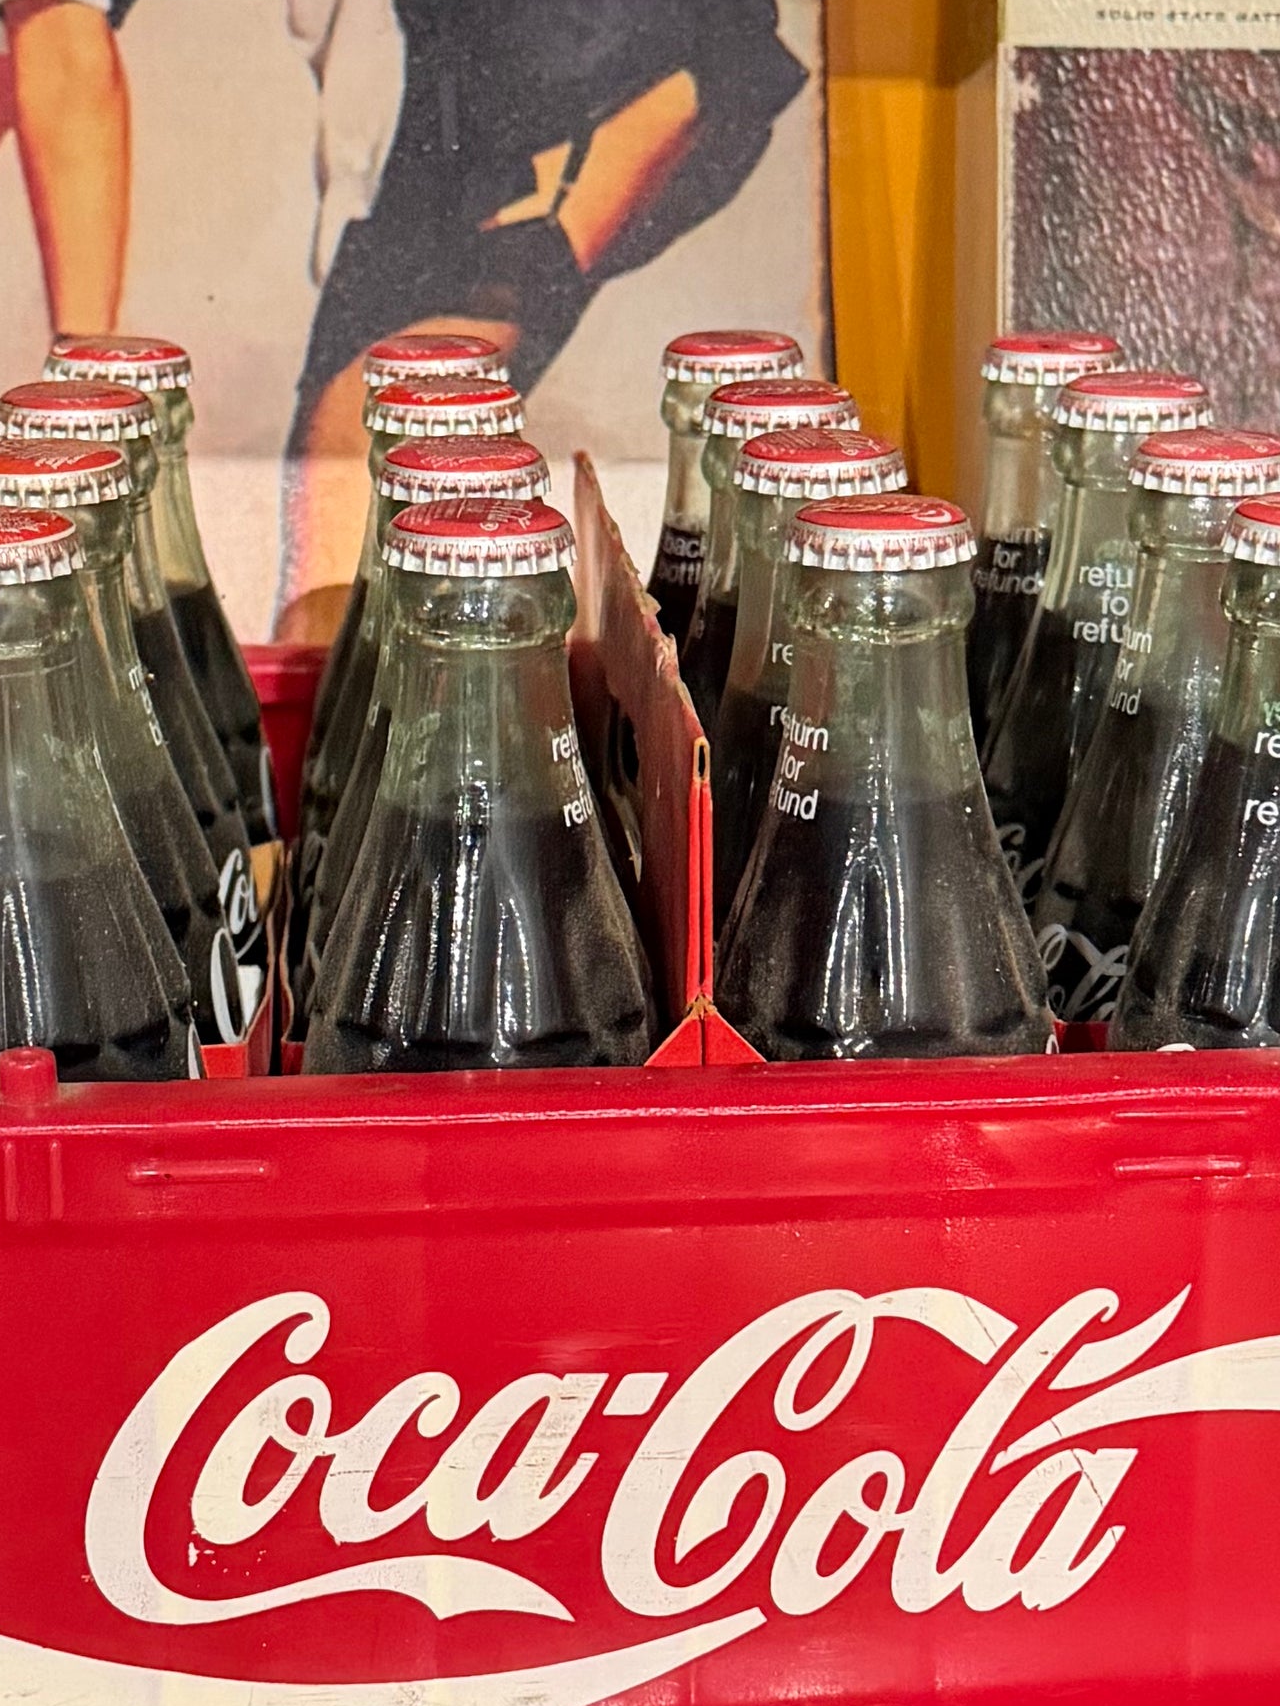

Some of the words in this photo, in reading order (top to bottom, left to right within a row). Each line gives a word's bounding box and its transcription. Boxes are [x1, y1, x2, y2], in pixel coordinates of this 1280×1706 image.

[1078, 561, 1134, 589] retu
[1100, 589, 1130, 617] fo
[1072, 617, 1124, 644] refu
[84, 1283, 1192, 1627] Coca-Cola
